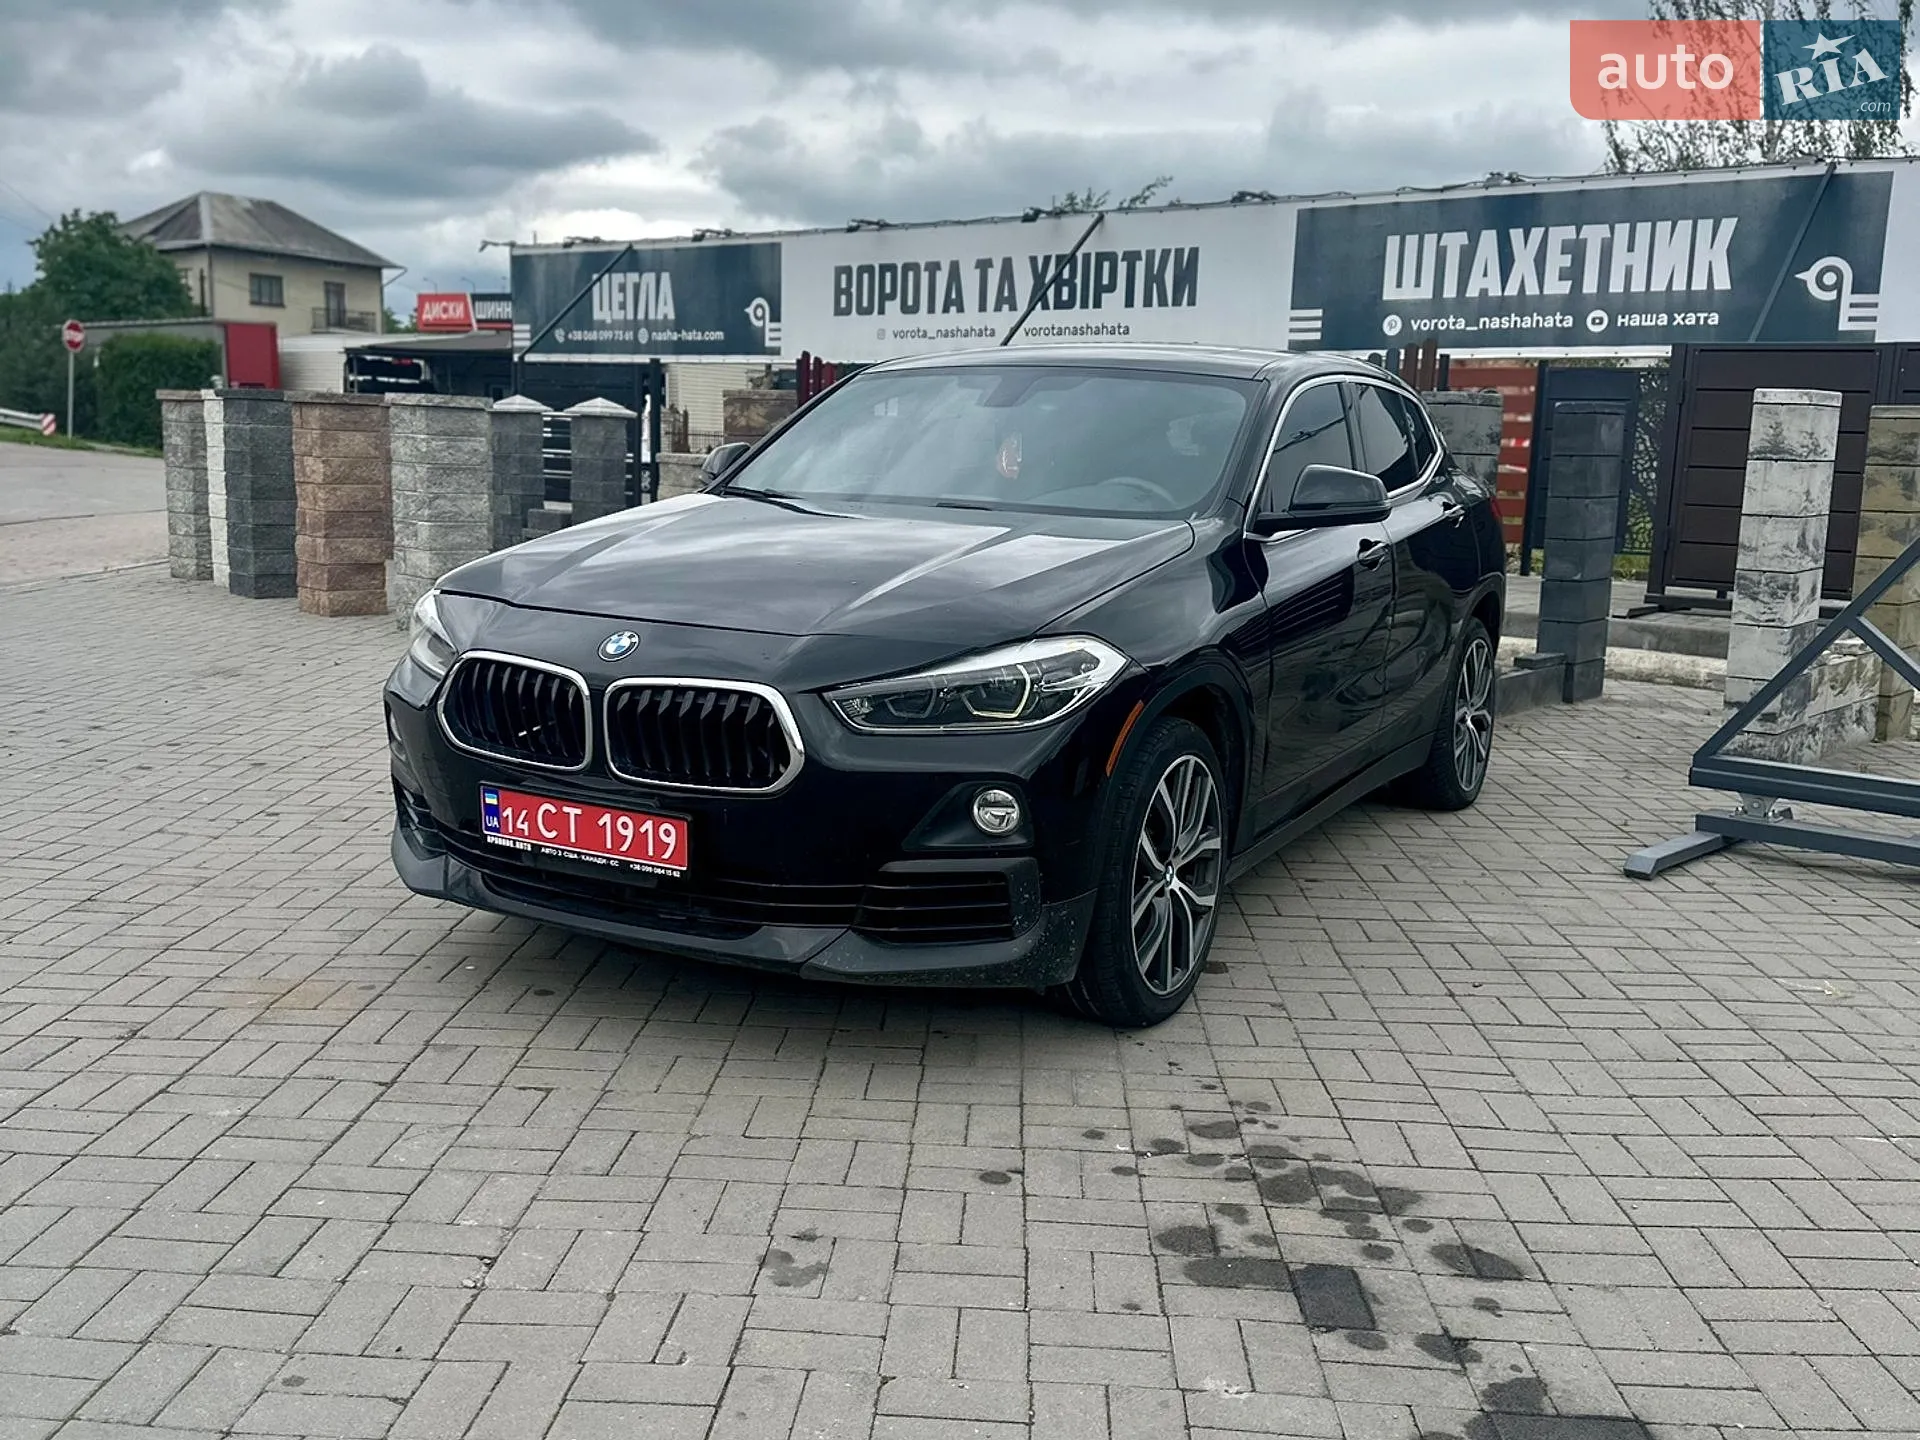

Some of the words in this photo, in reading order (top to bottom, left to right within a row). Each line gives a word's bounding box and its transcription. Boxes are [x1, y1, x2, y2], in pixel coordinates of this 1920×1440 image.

[1382, 217, 1738, 300] ШТАХЕТНИК
[833, 260, 964, 316] ВОРОТА
[974, 256, 1018, 313] ТА
[1026, 247, 1199, 311] ХВІРТКИ
[592, 272, 675, 323] ЦЕГЛА
[423, 301, 465, 320] ДИСКИ
[1617, 313, 1668, 327] наша
[1673, 312, 1719, 326] хата
[1024, 323, 1130, 336] vorotanashahata
[1410, 311, 1573, 331] vorota_nashahata
[651, 329, 724, 340] nasha-hata.com
[892, 325, 996, 339] vorota_nashahata
[485, 816, 499, 828] UA
[502, 807, 529, 837] 14
[537, 803, 582, 843] CT
[597, 813, 676, 860] 1919
